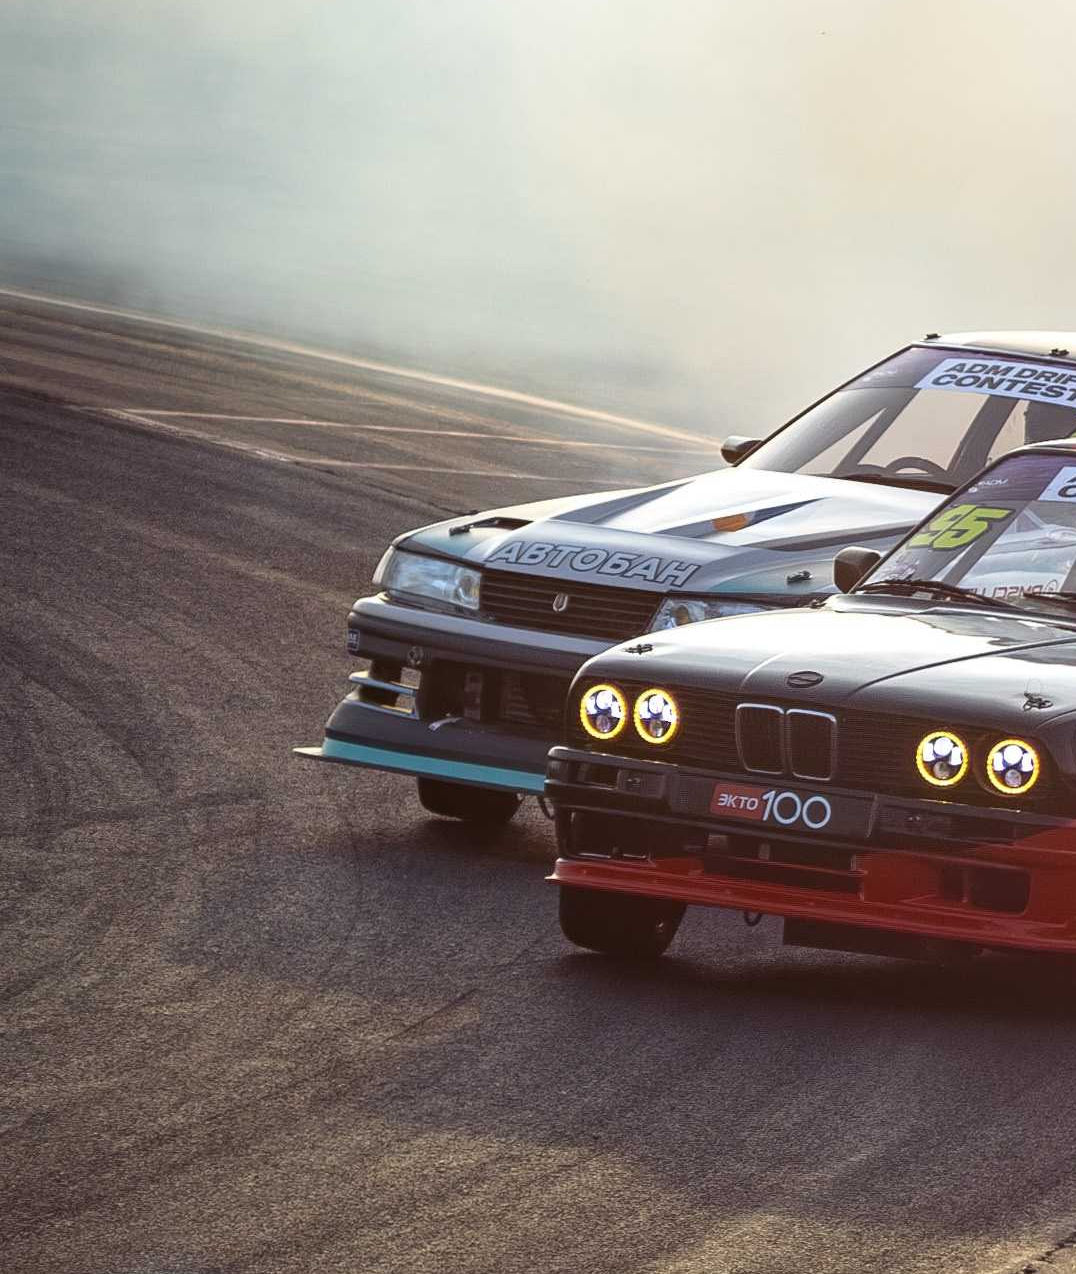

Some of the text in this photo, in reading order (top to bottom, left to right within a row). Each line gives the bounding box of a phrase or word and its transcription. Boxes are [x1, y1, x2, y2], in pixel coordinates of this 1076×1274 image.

[944, 361, 1016, 377] ADM
[907, 504, 1012, 549] 95
[484, 540, 703, 587] АВТОБАН
[717, 790, 831, 829] ЭКТО 100
